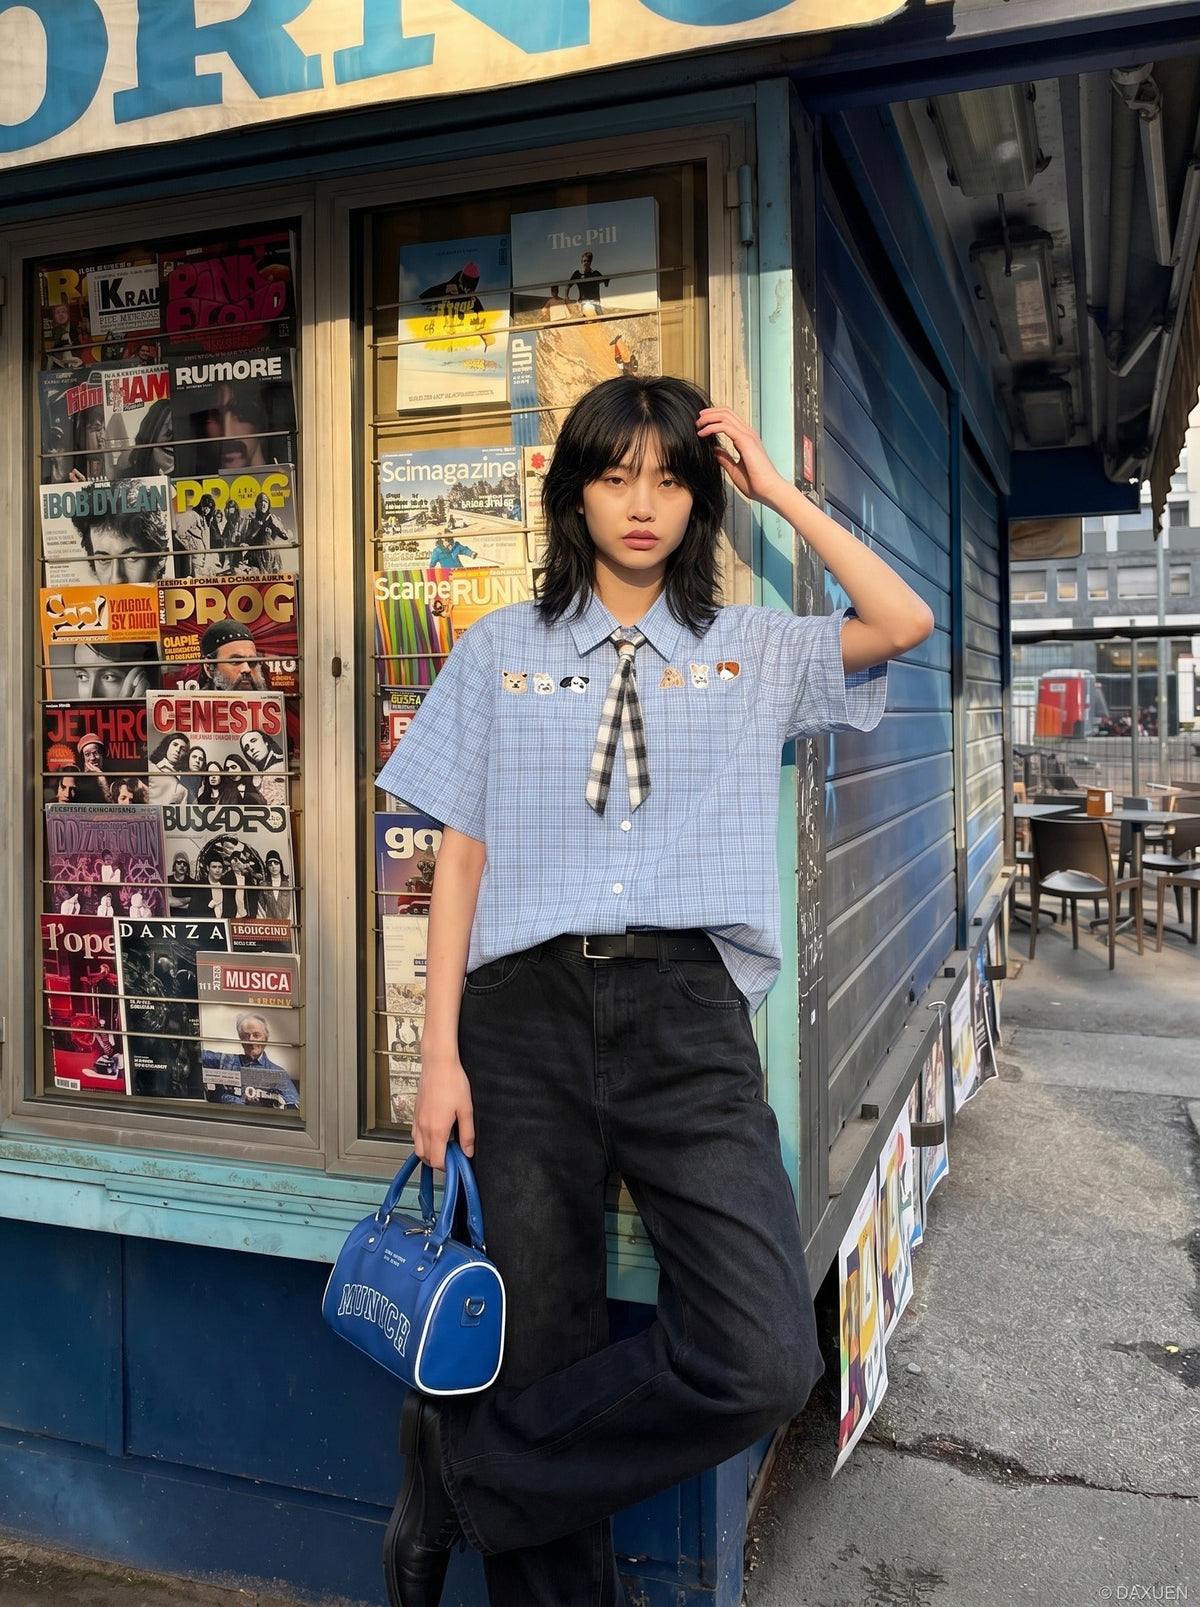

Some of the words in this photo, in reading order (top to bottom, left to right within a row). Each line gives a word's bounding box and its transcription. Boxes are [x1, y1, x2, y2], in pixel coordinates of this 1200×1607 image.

[548, 232, 583, 250] The
[585, 226, 617, 246] Pill
[382, 455, 516, 485] Scimagazine
[48, 490, 90, 519] BOB
[93, 484, 168, 516] DYLAN
[175, 473, 291, 513] PROG
[165, 583, 295, 626] PROG
[374, 577, 450, 605] Scarpe
[109, 742, 141, 759] WILL
[120, 923, 224, 940] DANZA
[226, 970, 290, 991] MUSICA
